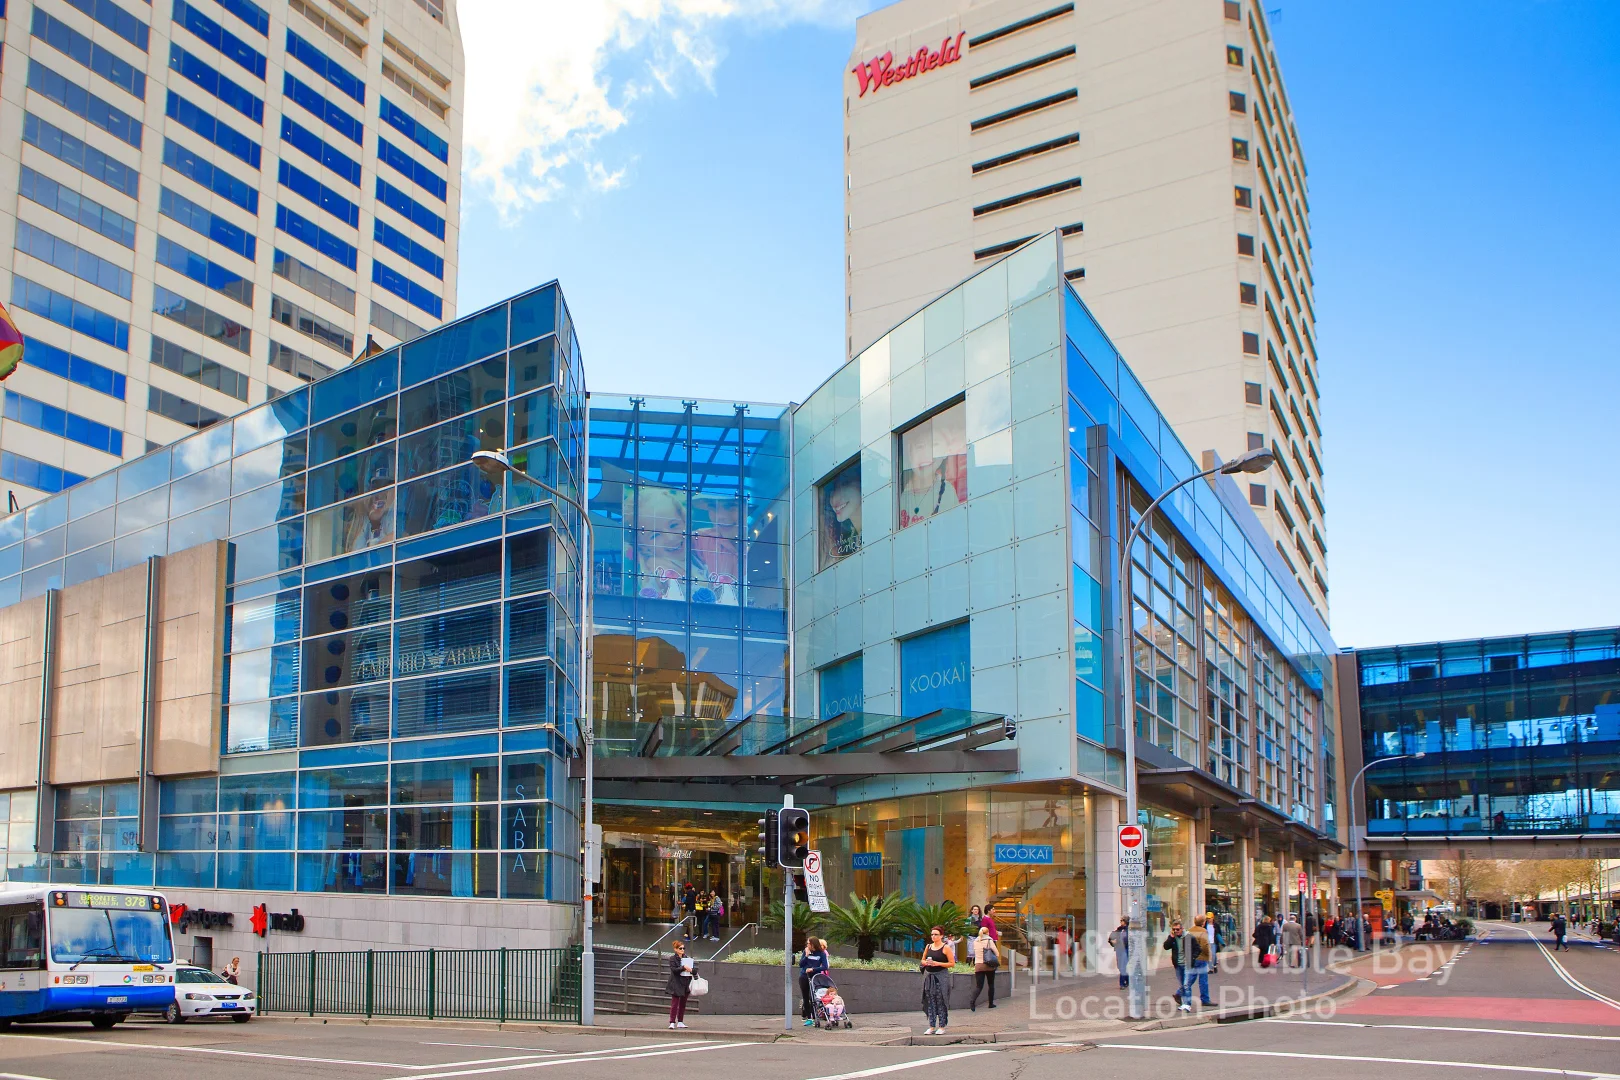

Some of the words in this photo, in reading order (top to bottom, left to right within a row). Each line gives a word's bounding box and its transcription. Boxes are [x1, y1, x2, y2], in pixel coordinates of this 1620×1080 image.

[852, 30, 966, 98] Westfield
[512, 784, 527, 873] SABA
[998, 846, 1050, 860] KOOKAÏ
[1124, 849, 1138, 857] NO
[809, 874, 820, 883] NO
[80, 894, 117, 902] BRONTE
[125, 896, 146, 907] 378
